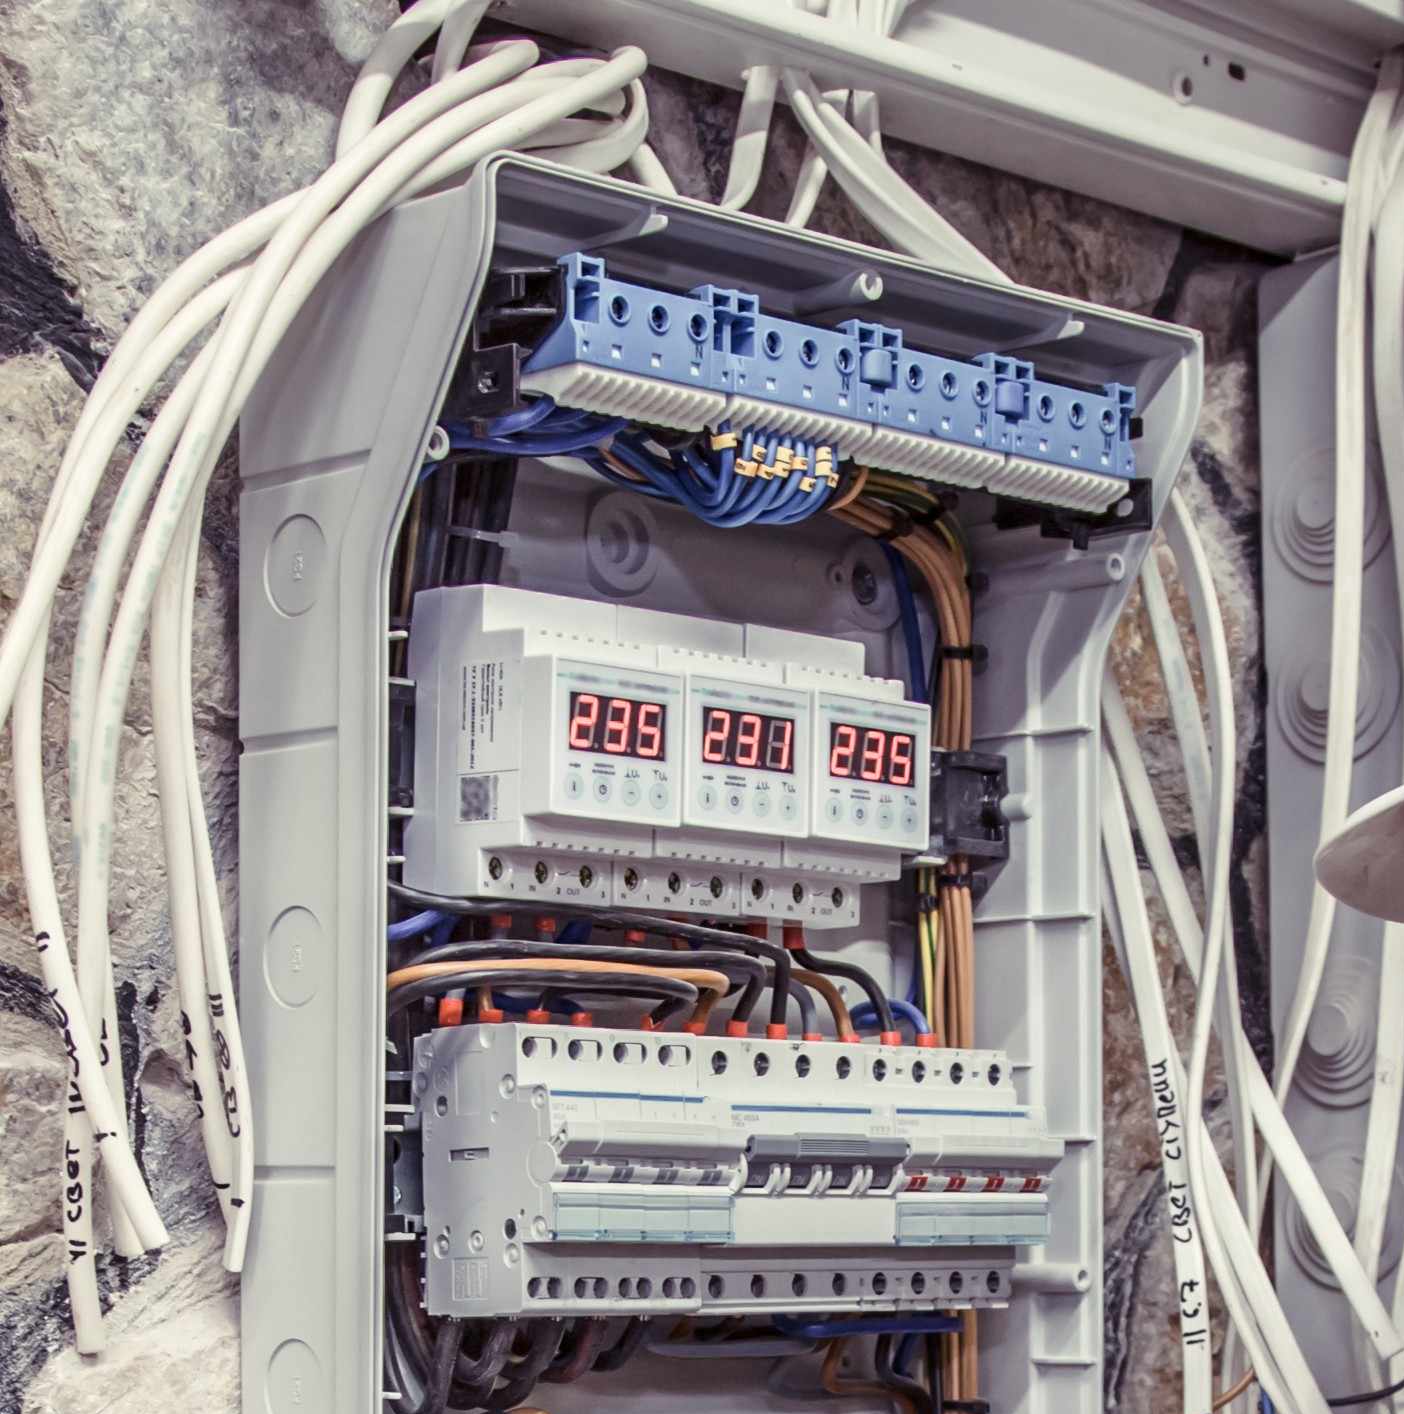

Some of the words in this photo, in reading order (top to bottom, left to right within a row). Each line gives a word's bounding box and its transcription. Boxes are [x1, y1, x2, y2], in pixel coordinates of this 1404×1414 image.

[570, 694, 662, 757] 235
[704, 710, 792, 769] 231
[830, 725, 911, 784] 235
